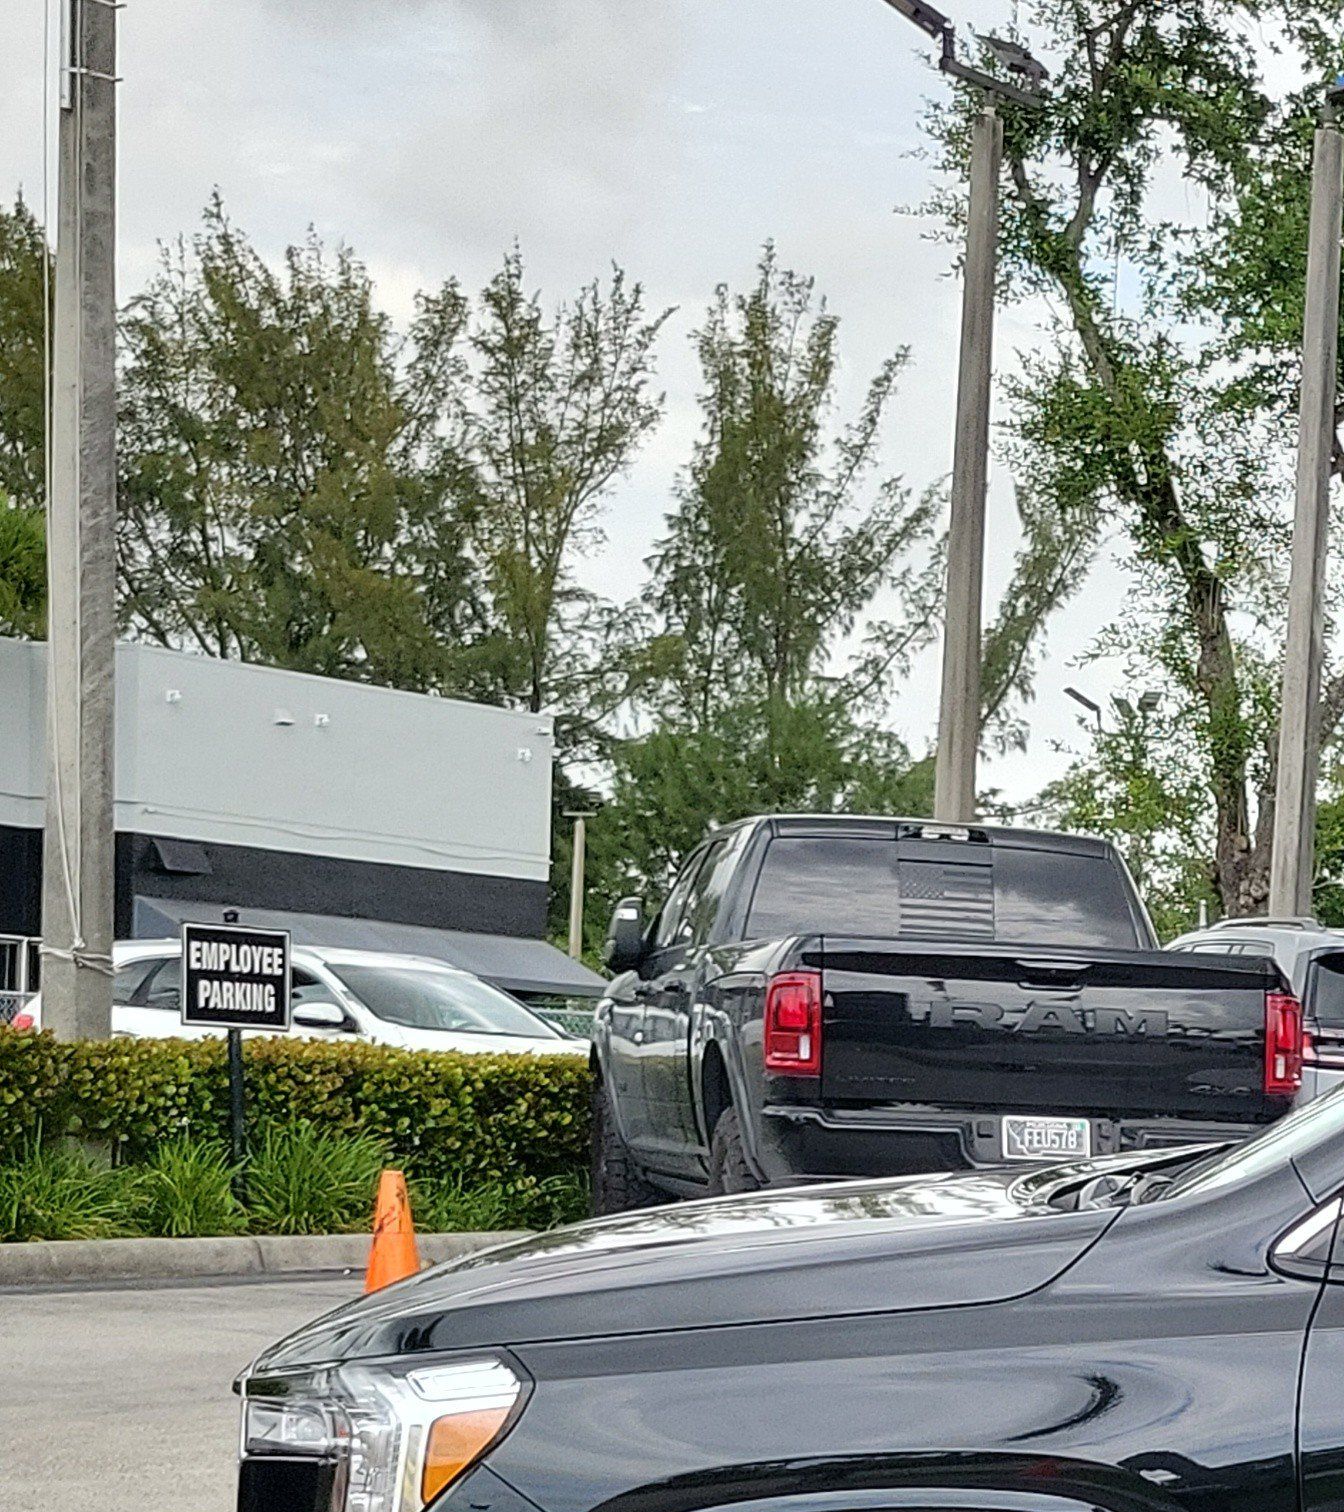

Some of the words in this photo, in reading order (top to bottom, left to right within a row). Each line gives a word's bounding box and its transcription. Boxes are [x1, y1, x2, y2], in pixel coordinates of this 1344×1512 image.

[189, 940, 284, 976] EMPLOYEE
[197, 979, 276, 1013] PARKING
[929, 1000, 1170, 1037] RAM
[1023, 1128, 1077, 1149] FEU578
